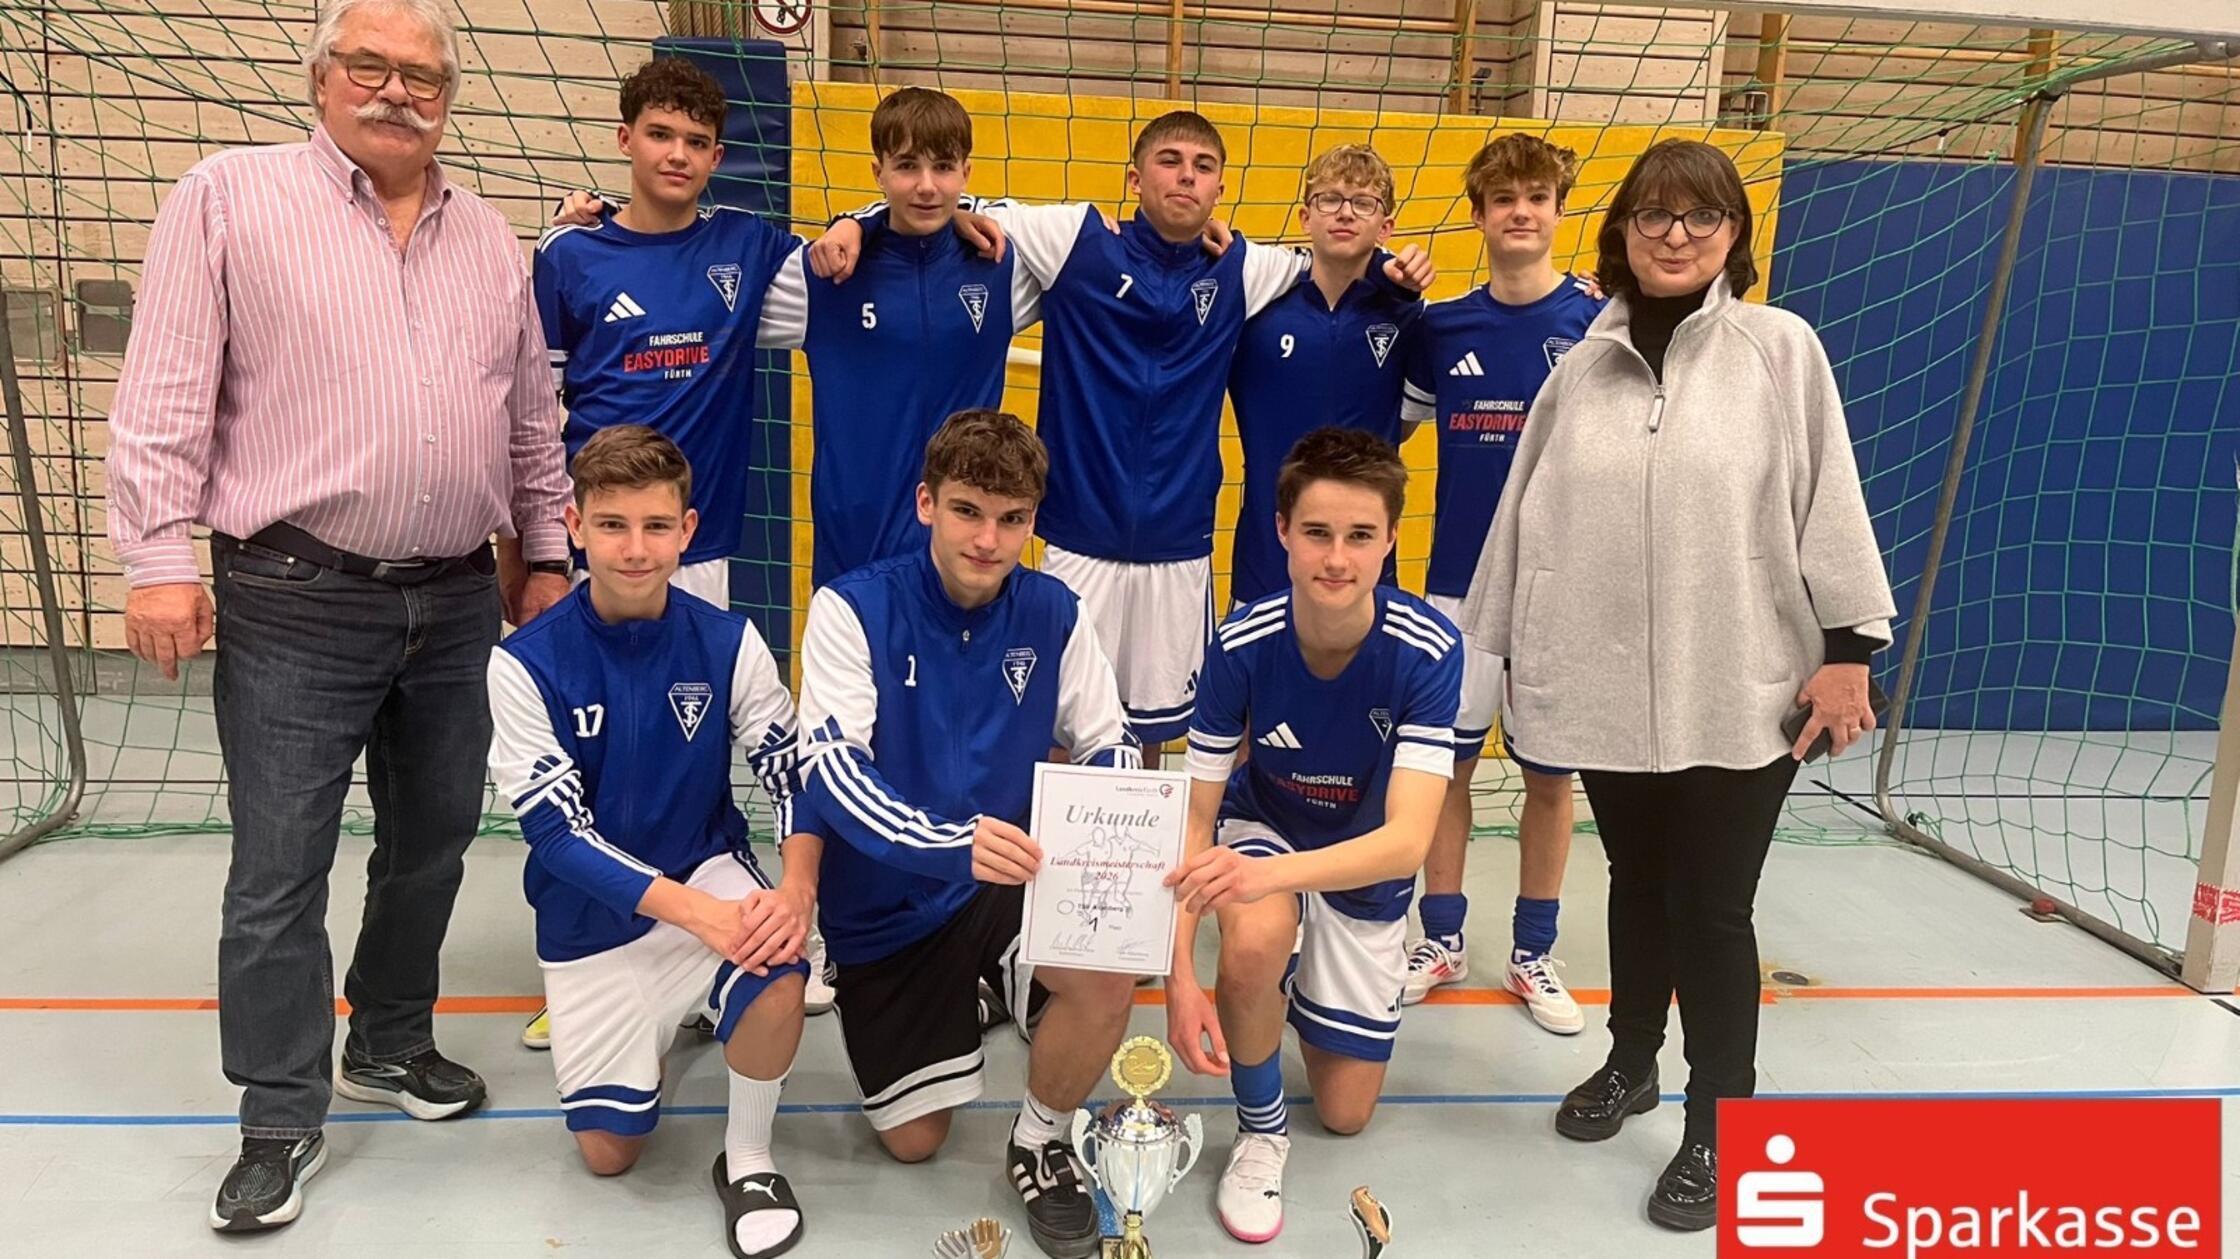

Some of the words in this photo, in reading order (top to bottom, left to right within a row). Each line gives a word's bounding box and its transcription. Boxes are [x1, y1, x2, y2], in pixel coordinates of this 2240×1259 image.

[1115, 273, 1134, 299] 7
[861, 302, 877, 329] 5
[649, 332, 704, 347] FAHRSCHULE
[1280, 334, 1295, 358] 9
[623, 346, 710, 373] EASYDRIVE
[664, 369, 692, 380] FÜRTH
[1473, 400, 1525, 411] FAHRSCHULE
[1479, 433, 1506, 442] FÜRTH
[904, 654, 917, 687] 1
[573, 703, 605, 738] 17
[1292, 772, 1353, 786] FAHRSCHULE
[1065, 804, 1160, 828] Urkunde
[1050, 856, 1166, 871] Landkreismeisterschaft
[1094, 871, 1120, 881] 2026
